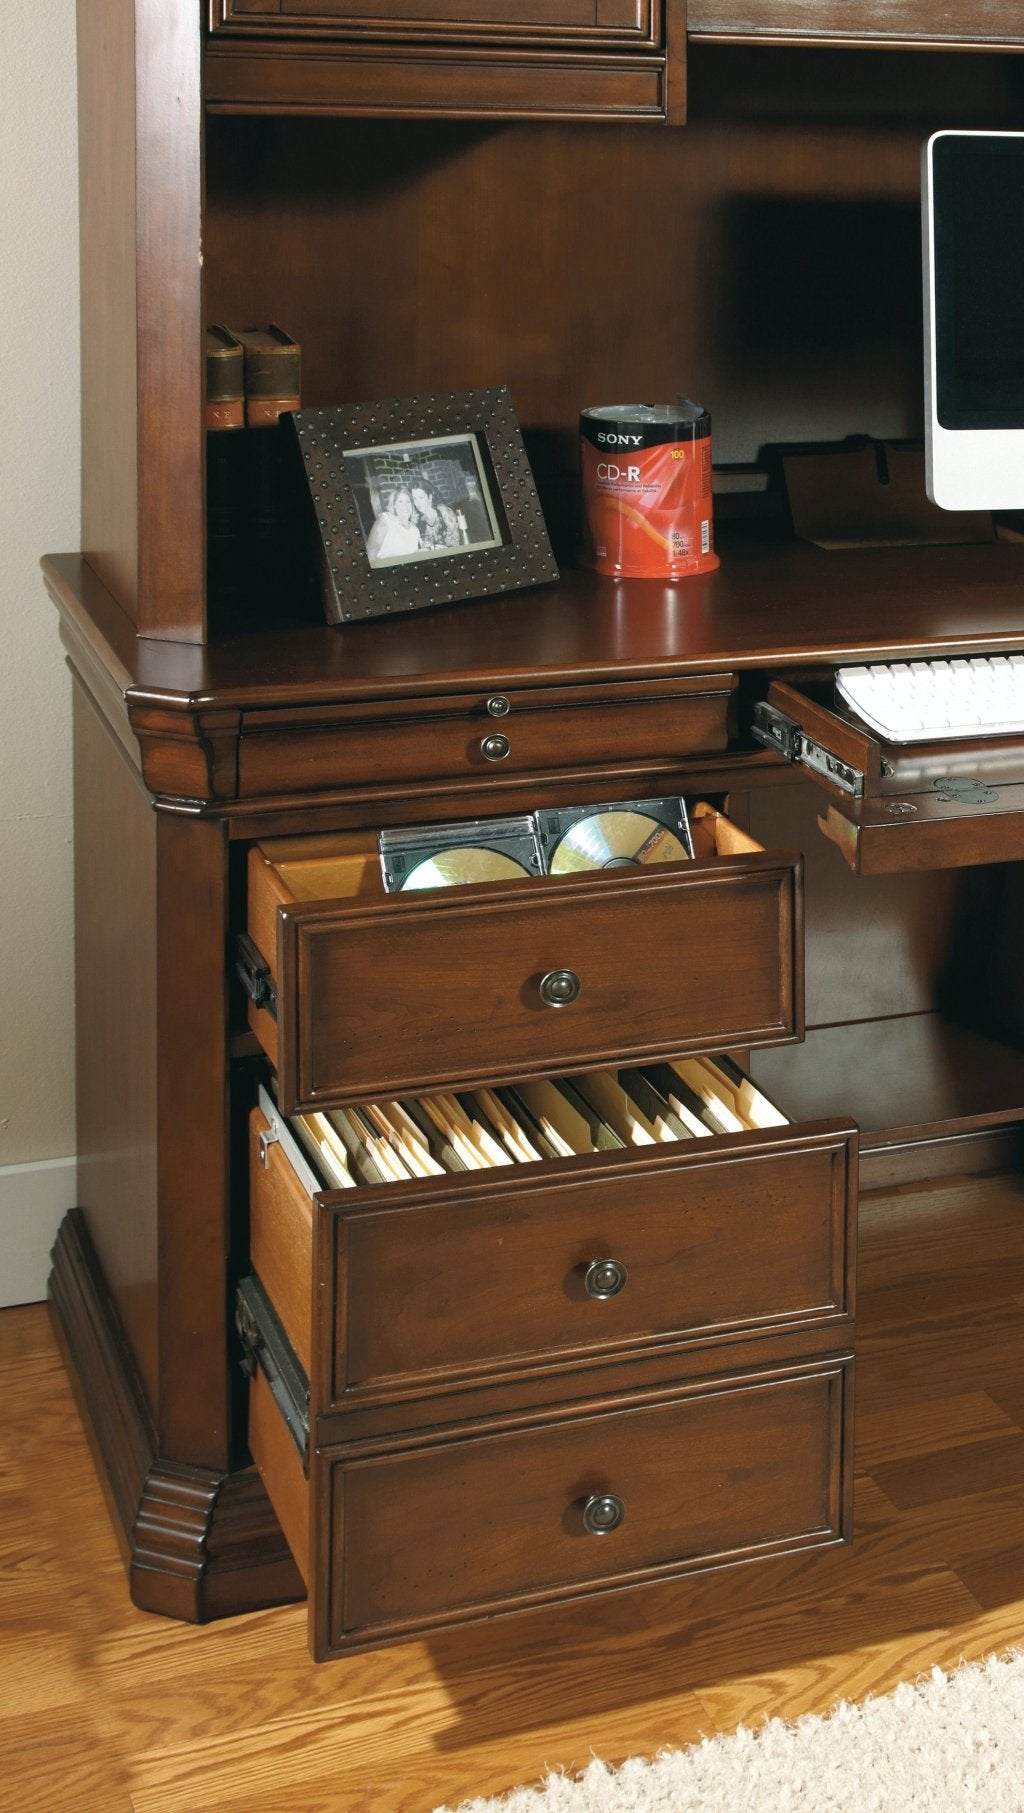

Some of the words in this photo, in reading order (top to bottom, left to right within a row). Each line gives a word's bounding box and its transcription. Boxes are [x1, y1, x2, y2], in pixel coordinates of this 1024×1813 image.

[597, 432, 643, 446] SONY
[671, 450, 685, 459] 100
[597, 463, 641, 482] CD-R
